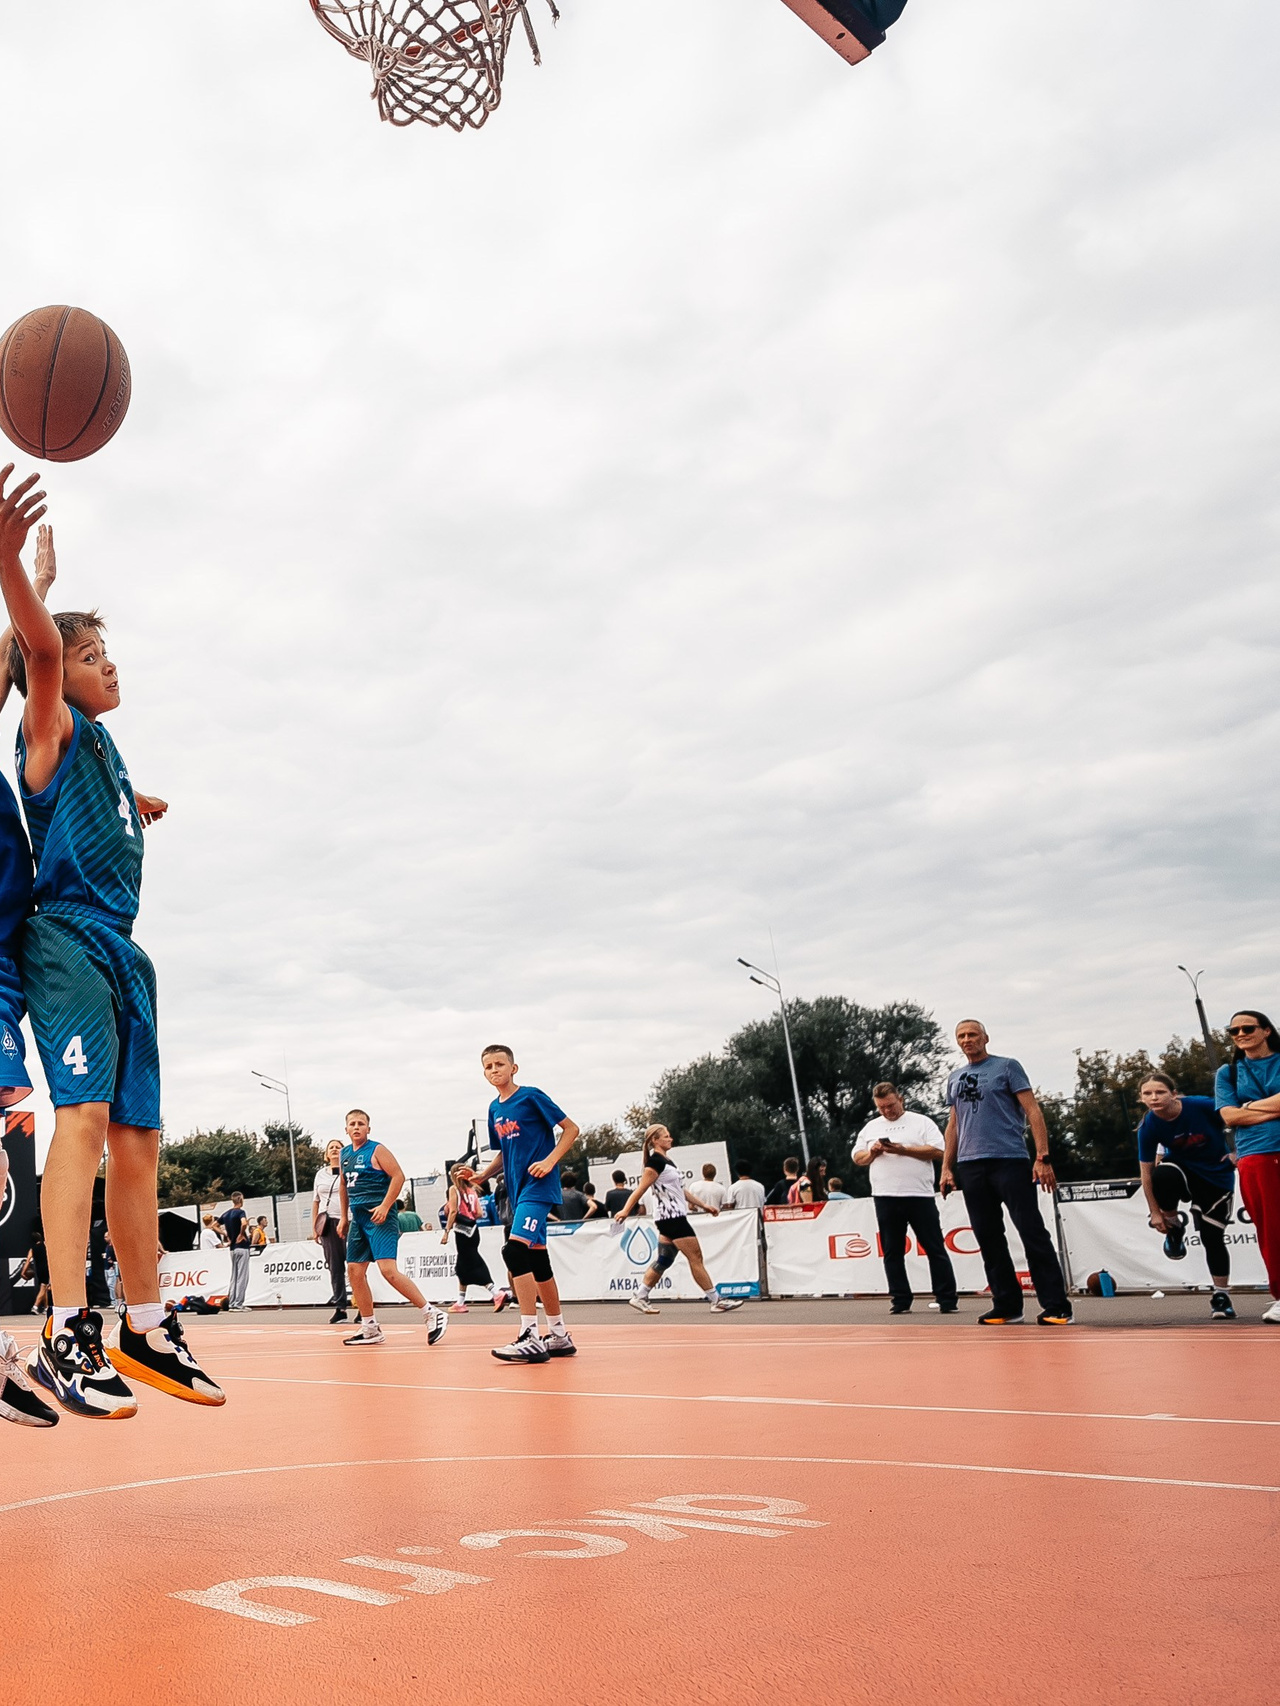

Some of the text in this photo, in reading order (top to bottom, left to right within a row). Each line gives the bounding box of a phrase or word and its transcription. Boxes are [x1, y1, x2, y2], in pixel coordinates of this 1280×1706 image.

[62, 1035, 88, 1075] 4
[522, 1217, 538, 1232] 16
[173, 1270, 209, 1287] DKC
[166, 1493, 831, 1628] dkc.ru
